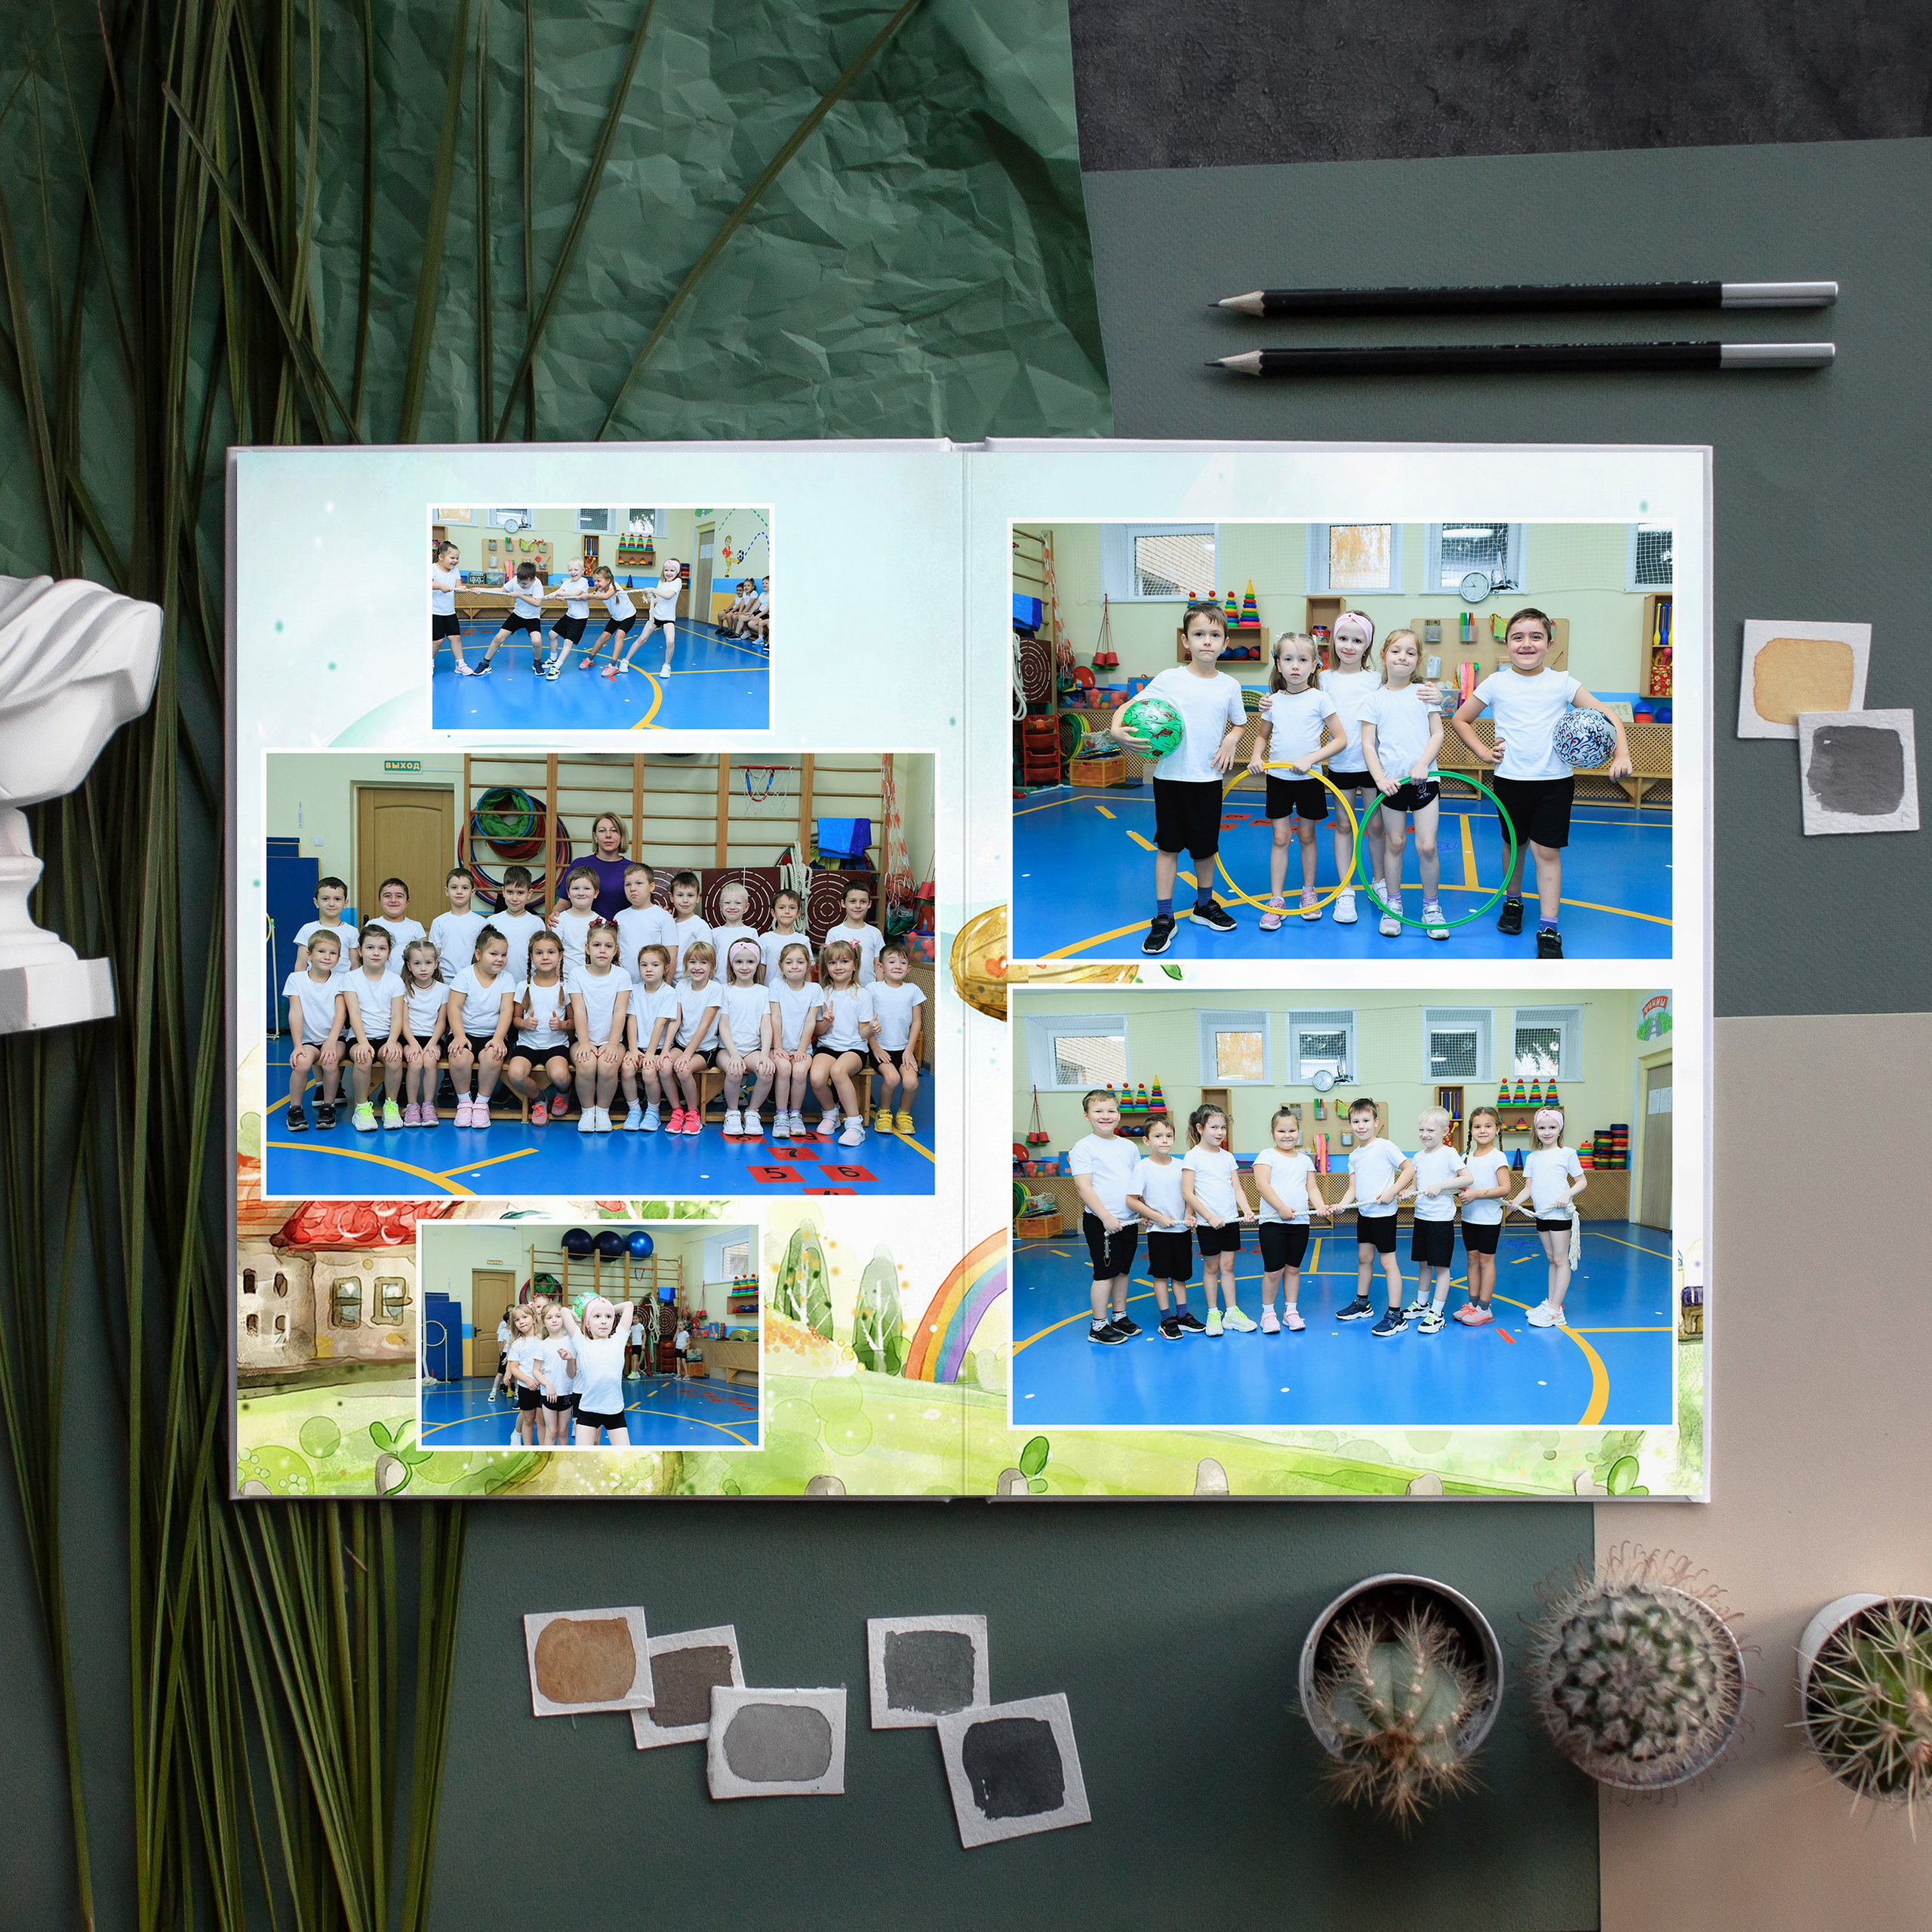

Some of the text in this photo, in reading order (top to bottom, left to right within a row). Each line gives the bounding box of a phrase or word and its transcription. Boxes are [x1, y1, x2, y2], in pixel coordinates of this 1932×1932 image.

[780, 1148, 798, 1158] 7
[762, 1168, 787, 1179] 5
[837, 1167, 860, 1177] 6
